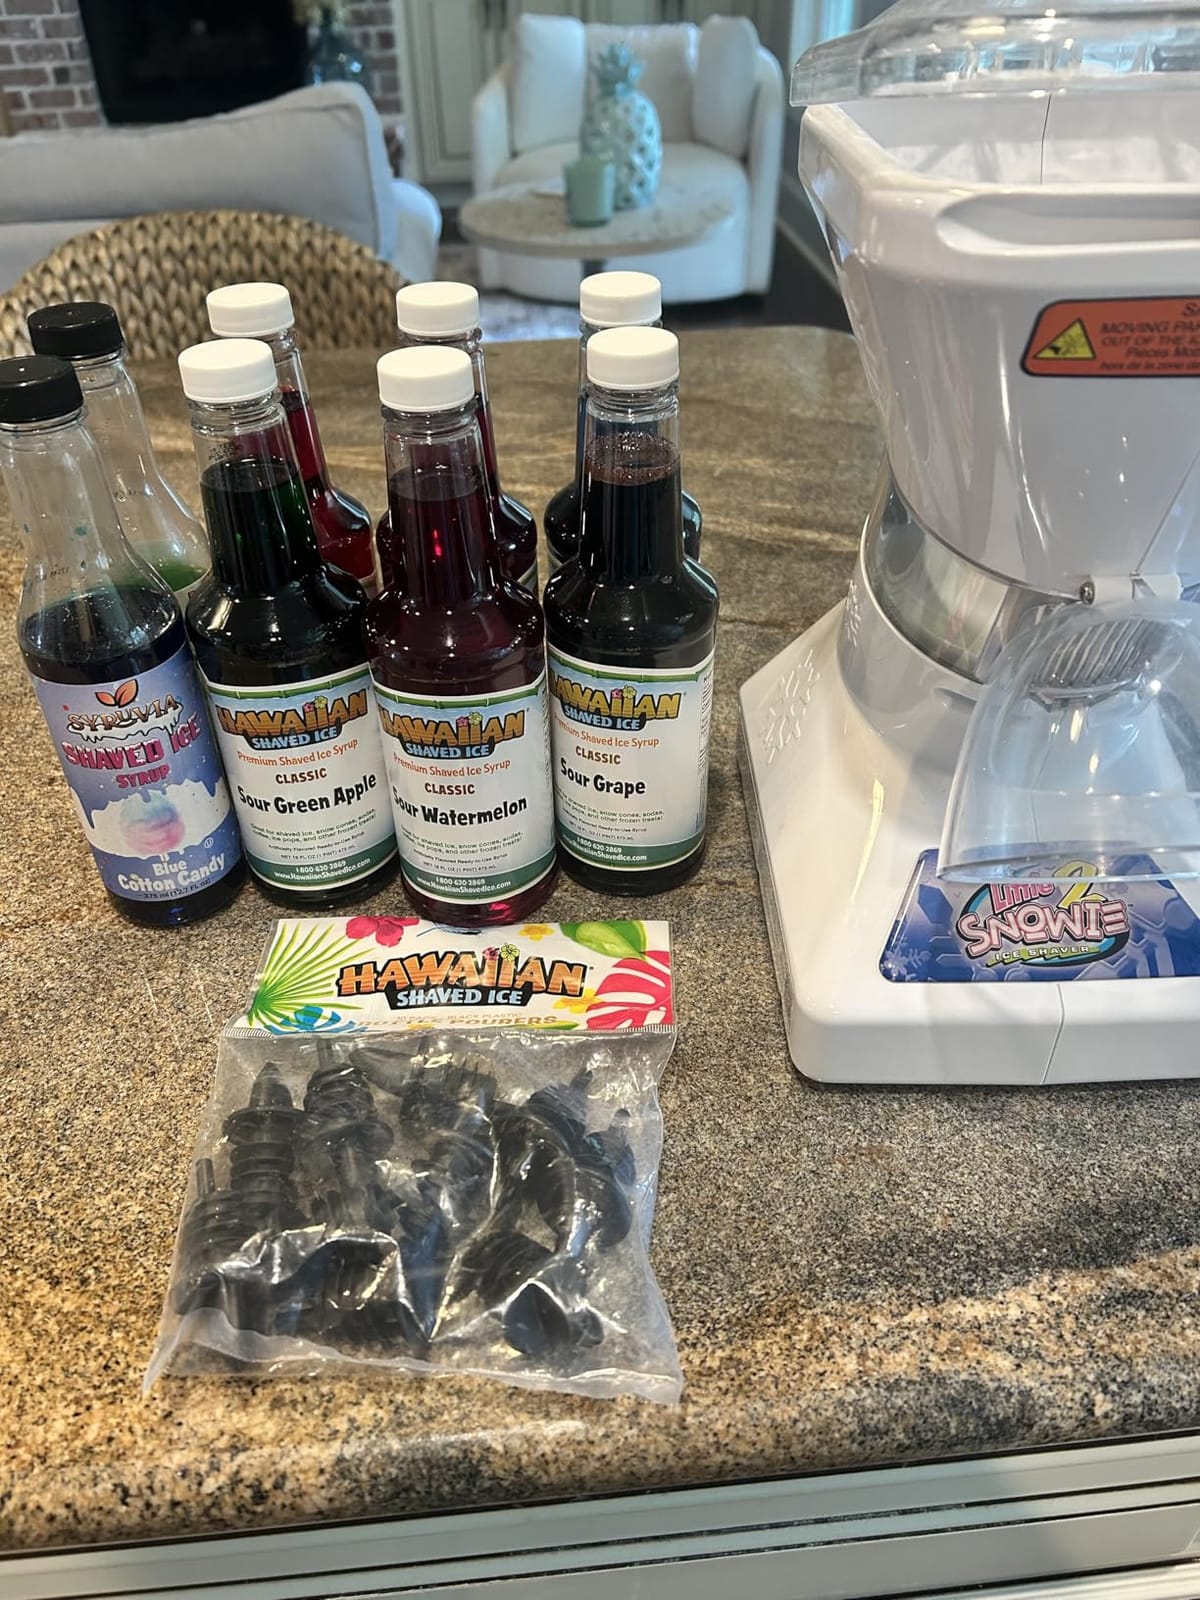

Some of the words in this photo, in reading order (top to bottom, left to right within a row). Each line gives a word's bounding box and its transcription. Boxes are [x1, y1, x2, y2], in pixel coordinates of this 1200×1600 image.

[1101, 321, 1169, 333] MOVING
[1101, 336, 1131, 346] OUT
[1134, 336, 1154, 345] OF
[1159, 335, 1184, 345] THE
[68, 694, 179, 731] SYRUVIA
[215, 688, 368, 736] HAWAIIAN
[564, 706, 613, 728] SHAVED
[616, 719, 640, 730] ICE
[252, 734, 310, 749] SHAVED
[314, 727, 337, 742] ICE
[378, 709, 525, 746] HAWAIIAN
[62, 739, 165, 770] SHAVED
[170, 713, 201, 753] ICE
[406, 743, 461, 758] SHAVED
[466, 745, 490, 757] ICE
[581, 731, 613, 746] Shaved
[615, 737, 630, 747] Ice
[631, 738, 659, 749] Syrup
[237, 751, 277, 766] Premium
[279, 751, 315, 766] Shaved
[317, 750, 331, 760] Ice
[333, 738, 358, 756] Syrup
[575, 745, 621, 765] CLASSIC
[393, 753, 427, 775] Premium
[430, 767, 465, 777] Shaved
[467, 767, 481, 776] Ice
[484, 760, 511, 775] Syrup
[116, 764, 170, 788] SYRUP
[275, 768, 327, 785] CLASSIC
[560, 757, 590, 788] Sour
[593, 774, 646, 799] Grape
[237, 785, 271, 812] Sour
[274, 797, 330, 814] Green
[334, 773, 377, 806] Apple
[425, 783, 475, 795] CLASSIC
[393, 786, 419, 818] Sour
[421, 797, 527, 826] Watermelon
[319, 831, 336, 840] other
[338, 824, 358, 835] frozen
[480, 845, 502, 853] frozen
[592, 841, 604, 851] 620
[606, 845, 622, 853] 2869
[118, 874, 176, 891] Cotton
[177, 853, 225, 885] Candy
[152, 860, 187, 876] Blue
[329, 860, 346, 870] 2869
[958, 900, 1129, 957] SNOWIE
[995, 950, 1021, 960] ICE
[1028, 945, 1089, 956] SHAVER
[338, 952, 587, 997] HAWAIIAN
[396, 989, 481, 1007] SHAVED
[488, 990, 523, 1005] ICE
[450, 1016, 558, 1025] POURERS
